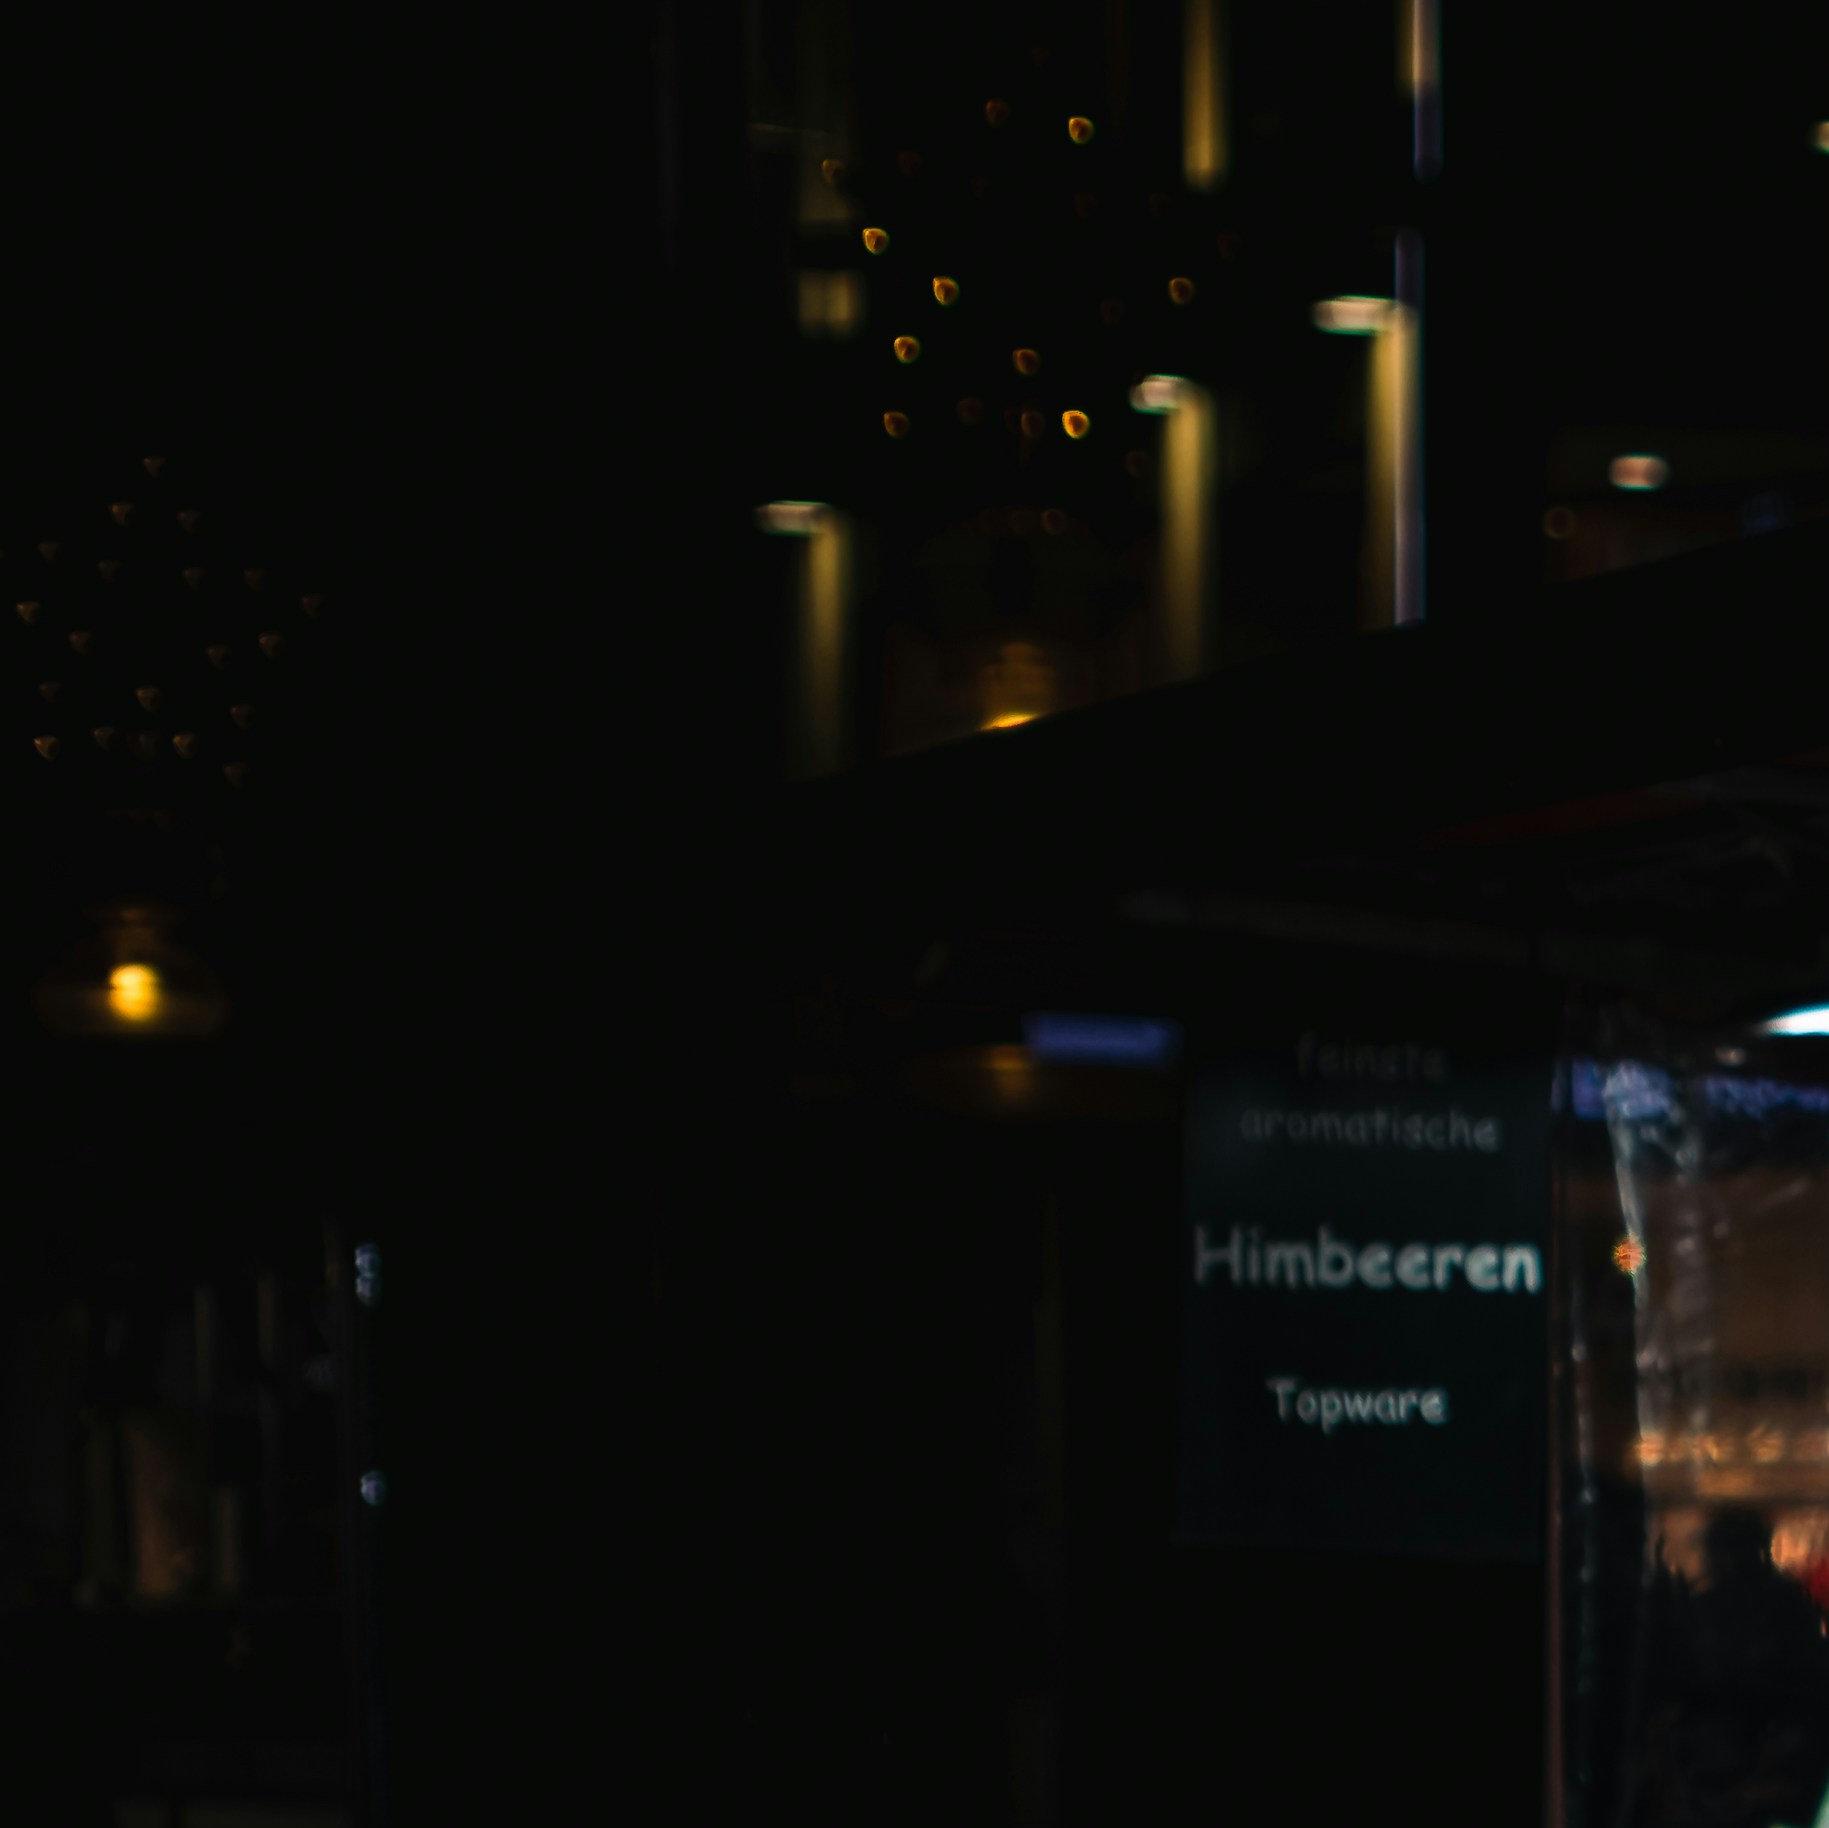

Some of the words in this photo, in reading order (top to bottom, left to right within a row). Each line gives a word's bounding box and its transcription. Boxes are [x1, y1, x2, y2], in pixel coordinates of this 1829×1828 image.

[1239, 1106, 1502, 1154] aromatische
[1192, 1222, 1543, 1295] Himbeeren
[1265, 1375, 1451, 1436] Topware
